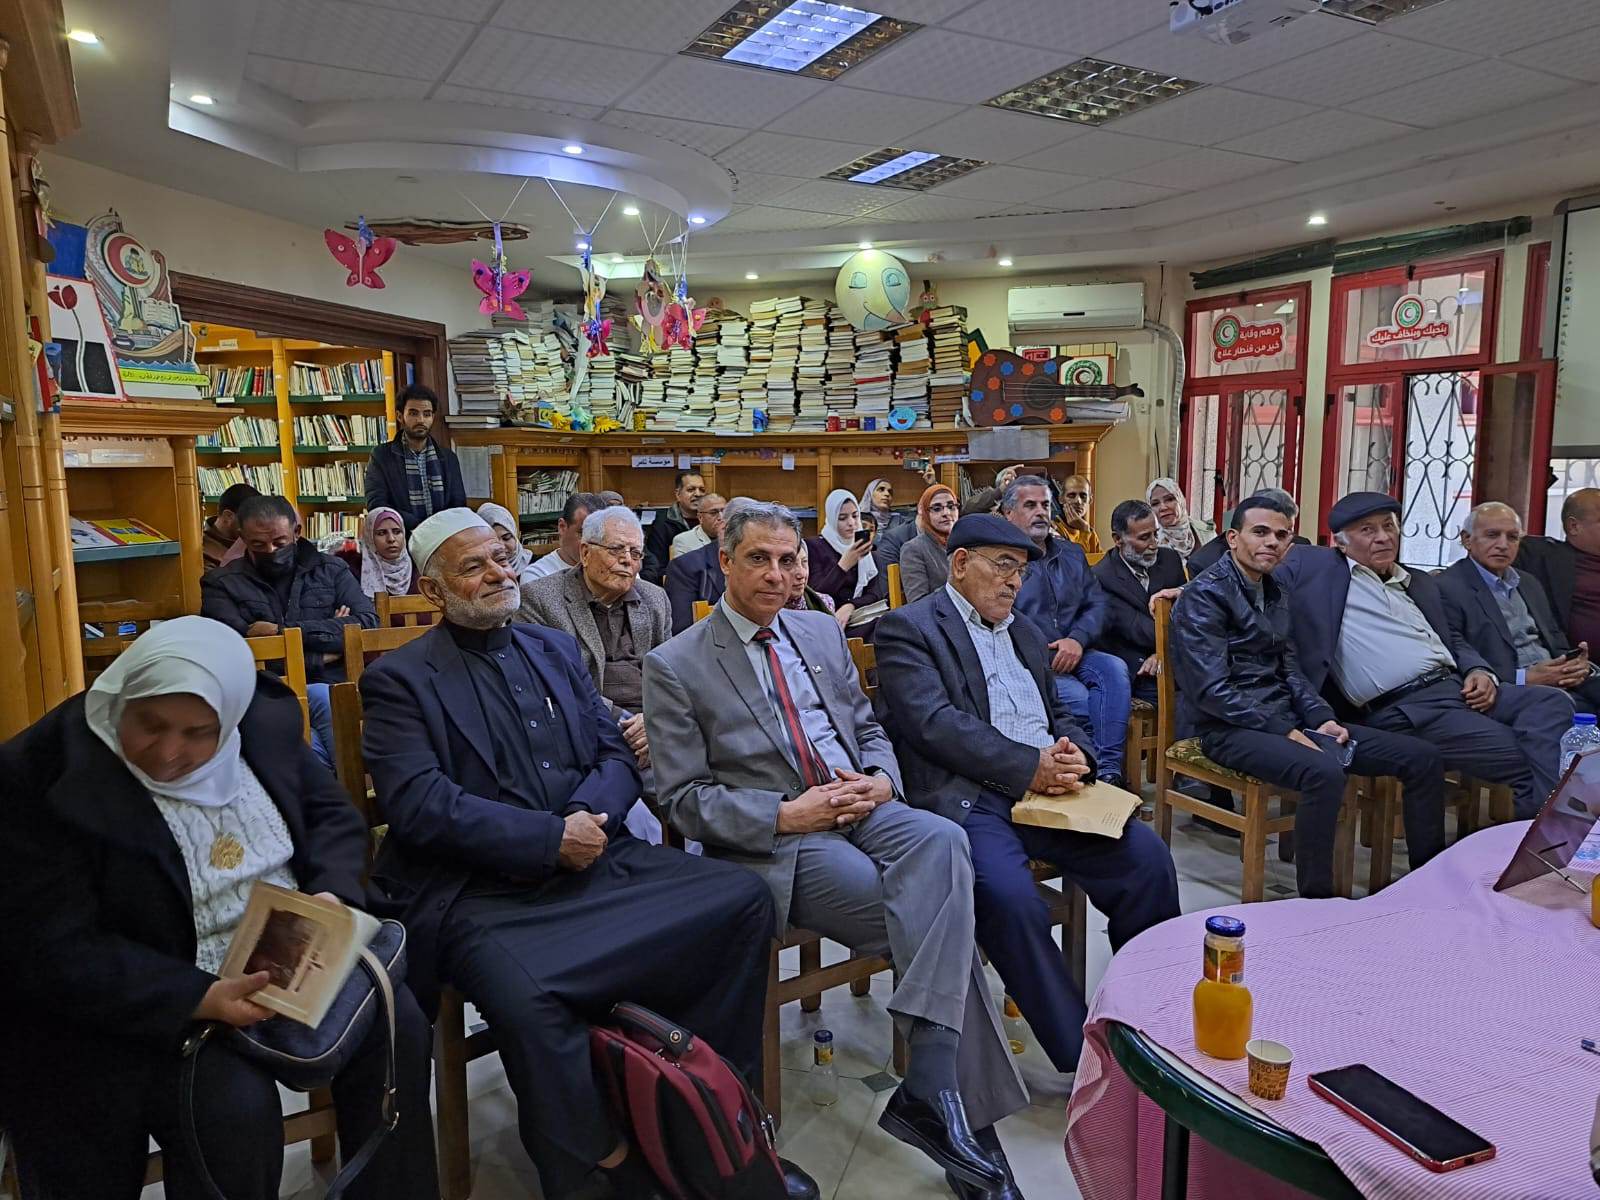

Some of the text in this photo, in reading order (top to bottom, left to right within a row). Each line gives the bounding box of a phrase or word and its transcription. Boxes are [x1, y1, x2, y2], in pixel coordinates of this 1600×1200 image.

[1240, 329, 1258, 340] وقاية
[1259, 327, 1280, 337] درهم
[1372, 332, 1392, 344] عليك
[1217, 341, 1280, 359] خير من قنطار علاج
